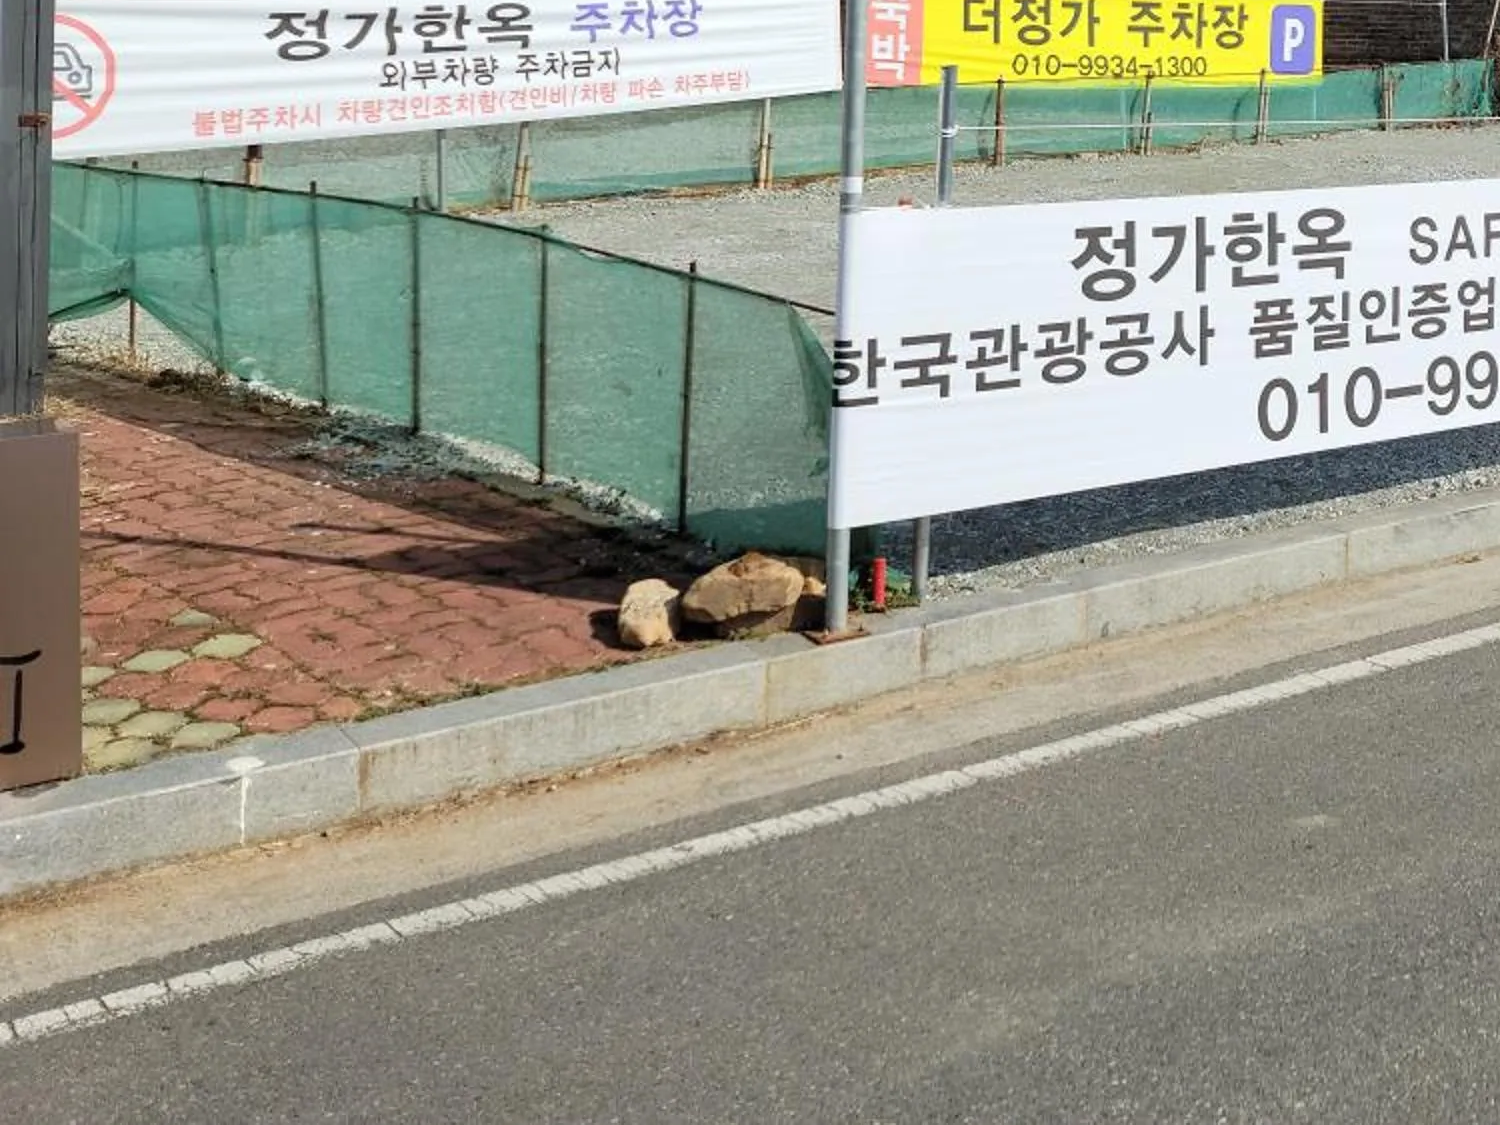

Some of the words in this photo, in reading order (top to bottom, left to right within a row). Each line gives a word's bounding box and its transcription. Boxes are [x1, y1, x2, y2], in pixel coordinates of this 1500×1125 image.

[264, 2, 535, 62] 정가한옥
[1127, 1, 1249, 50] 주차장
[1283, 18, 1305, 62] P
[378, 55, 499, 90] 외부차량
[515, 47, 621, 82] 주차금지
[1012, 54, 1207, 78] 010-9934-1300
[192, 102, 322, 137] 불법주차시
[628, 80, 665, 99] 파손
[1071, 208, 1352, 302] 정가한옥
[832, 305, 1216, 408] 한국관광공사
